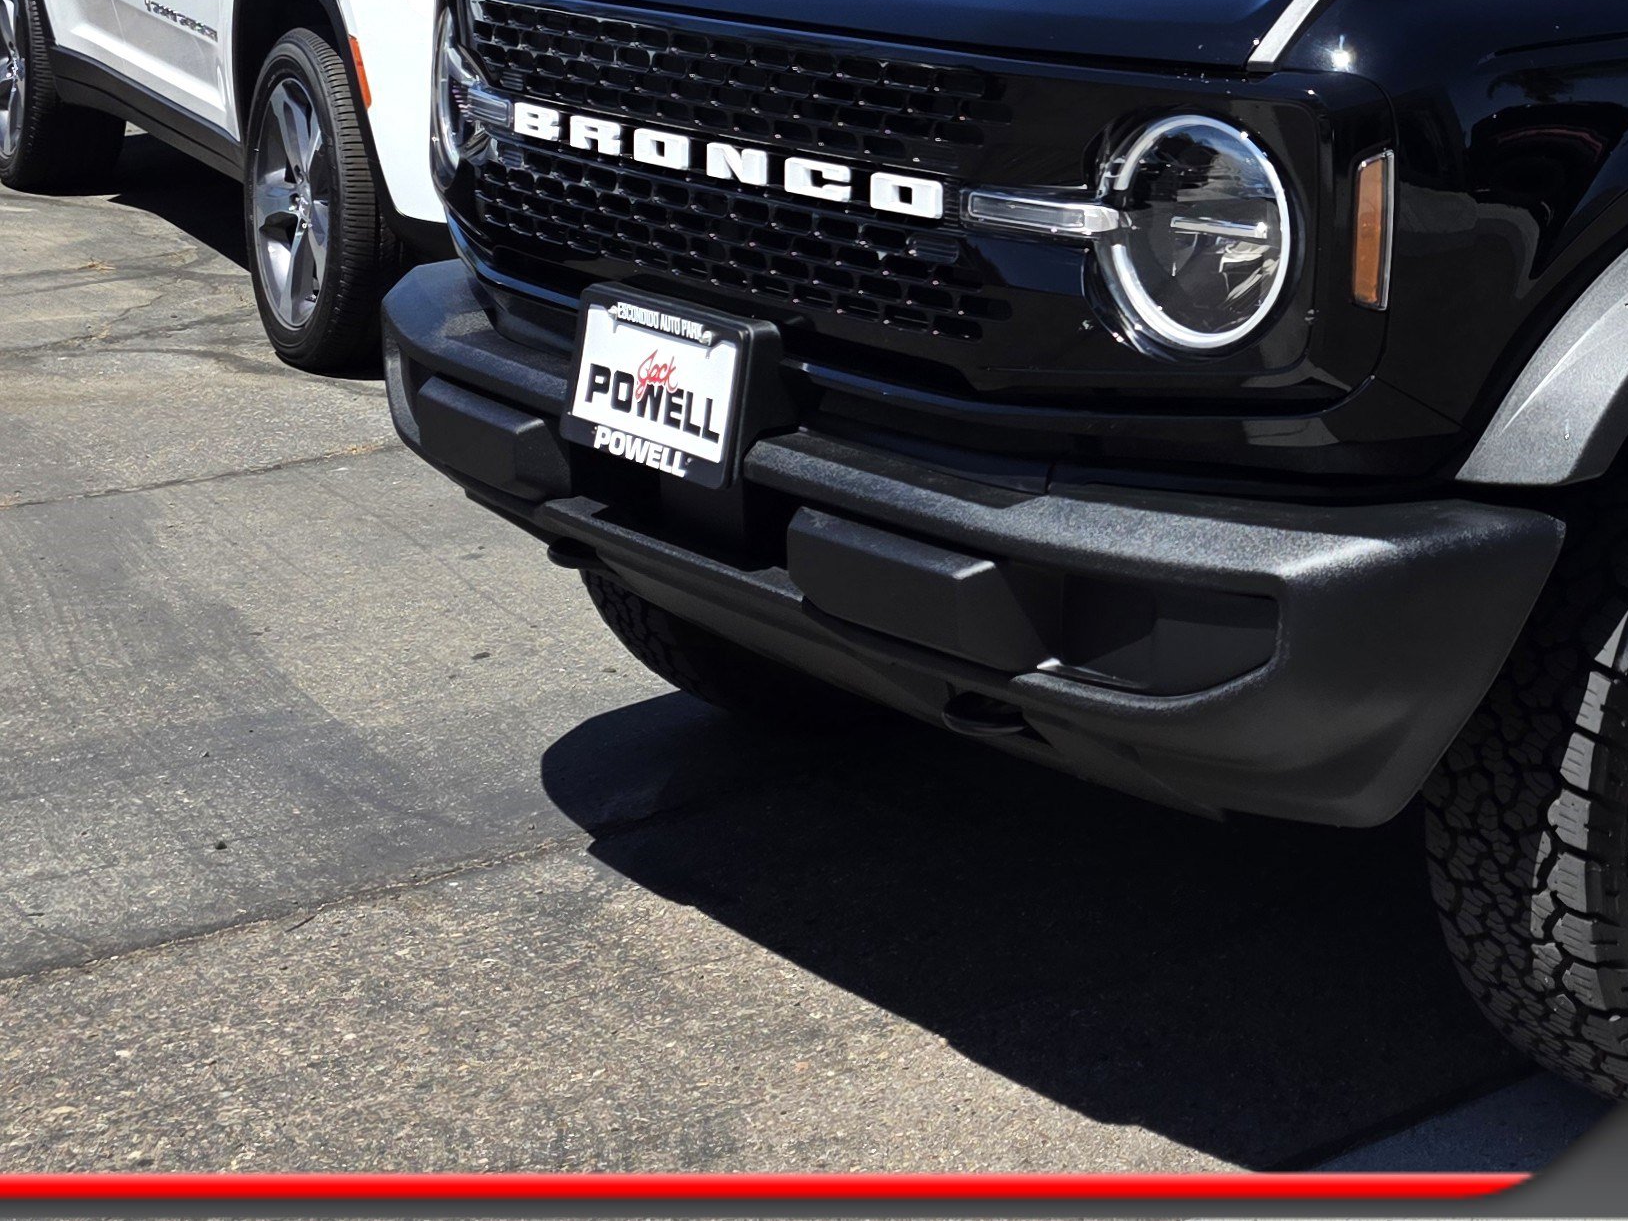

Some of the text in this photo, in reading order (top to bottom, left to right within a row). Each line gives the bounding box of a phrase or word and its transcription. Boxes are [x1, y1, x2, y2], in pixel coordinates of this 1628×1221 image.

[513, 101, 943, 220] BRONCO
[660, 313, 681, 337] AUTO
[635, 348, 679, 401] Jack
[585, 363, 720, 444] POWELL
[593, 425, 687, 478] POWELL
